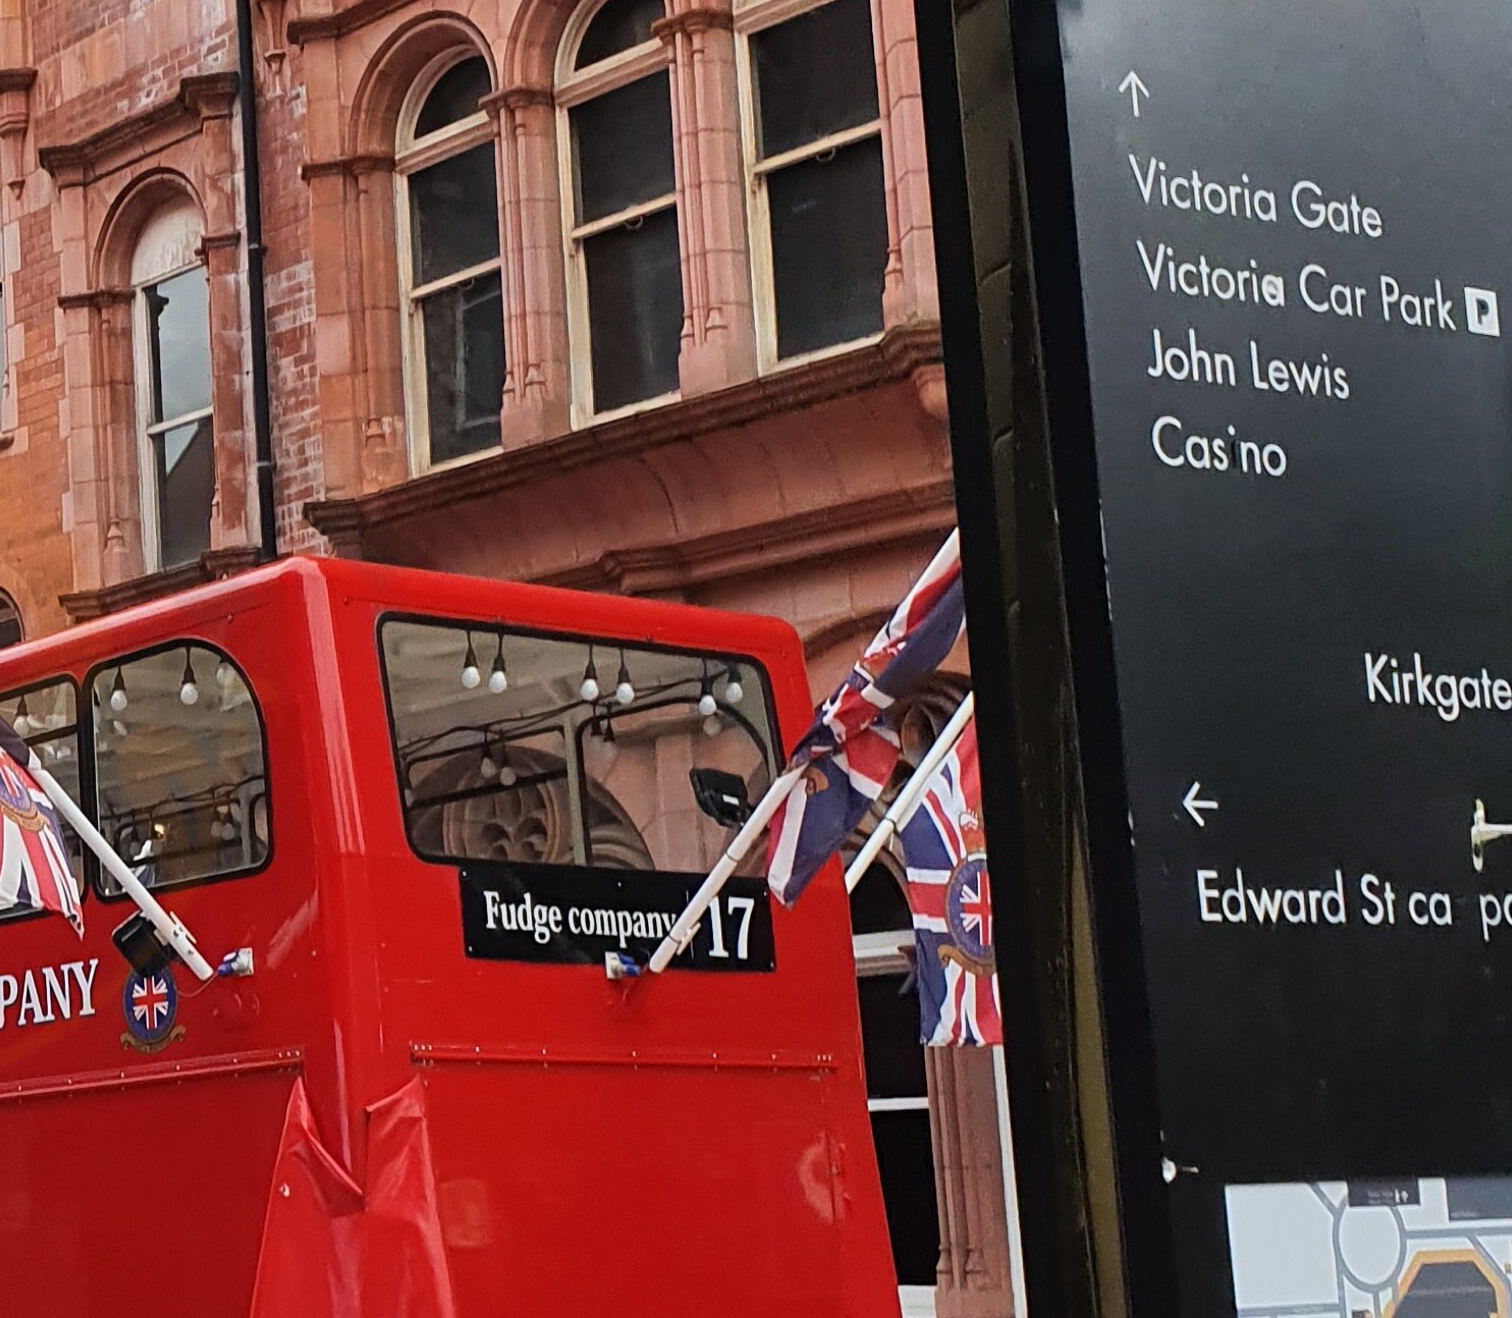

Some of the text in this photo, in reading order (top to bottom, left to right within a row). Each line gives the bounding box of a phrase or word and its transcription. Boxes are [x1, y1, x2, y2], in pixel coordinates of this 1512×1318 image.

[1127, 152, 1384, 238] Victoria Gate
[1136, 239, 1286, 308] Victoria
[1299, 263, 1367, 318] Car
[1380, 274, 1458, 332] Park
[1146, 328, 1351, 401] John Lewis
[1364, 651, 1512, 722] Kirkgate
[483, 890, 563, 945] Fudge
[707, 895, 756, 960] 17
[1196, 867, 1347, 924] Edward
[1359, 873, 1396, 926] St
